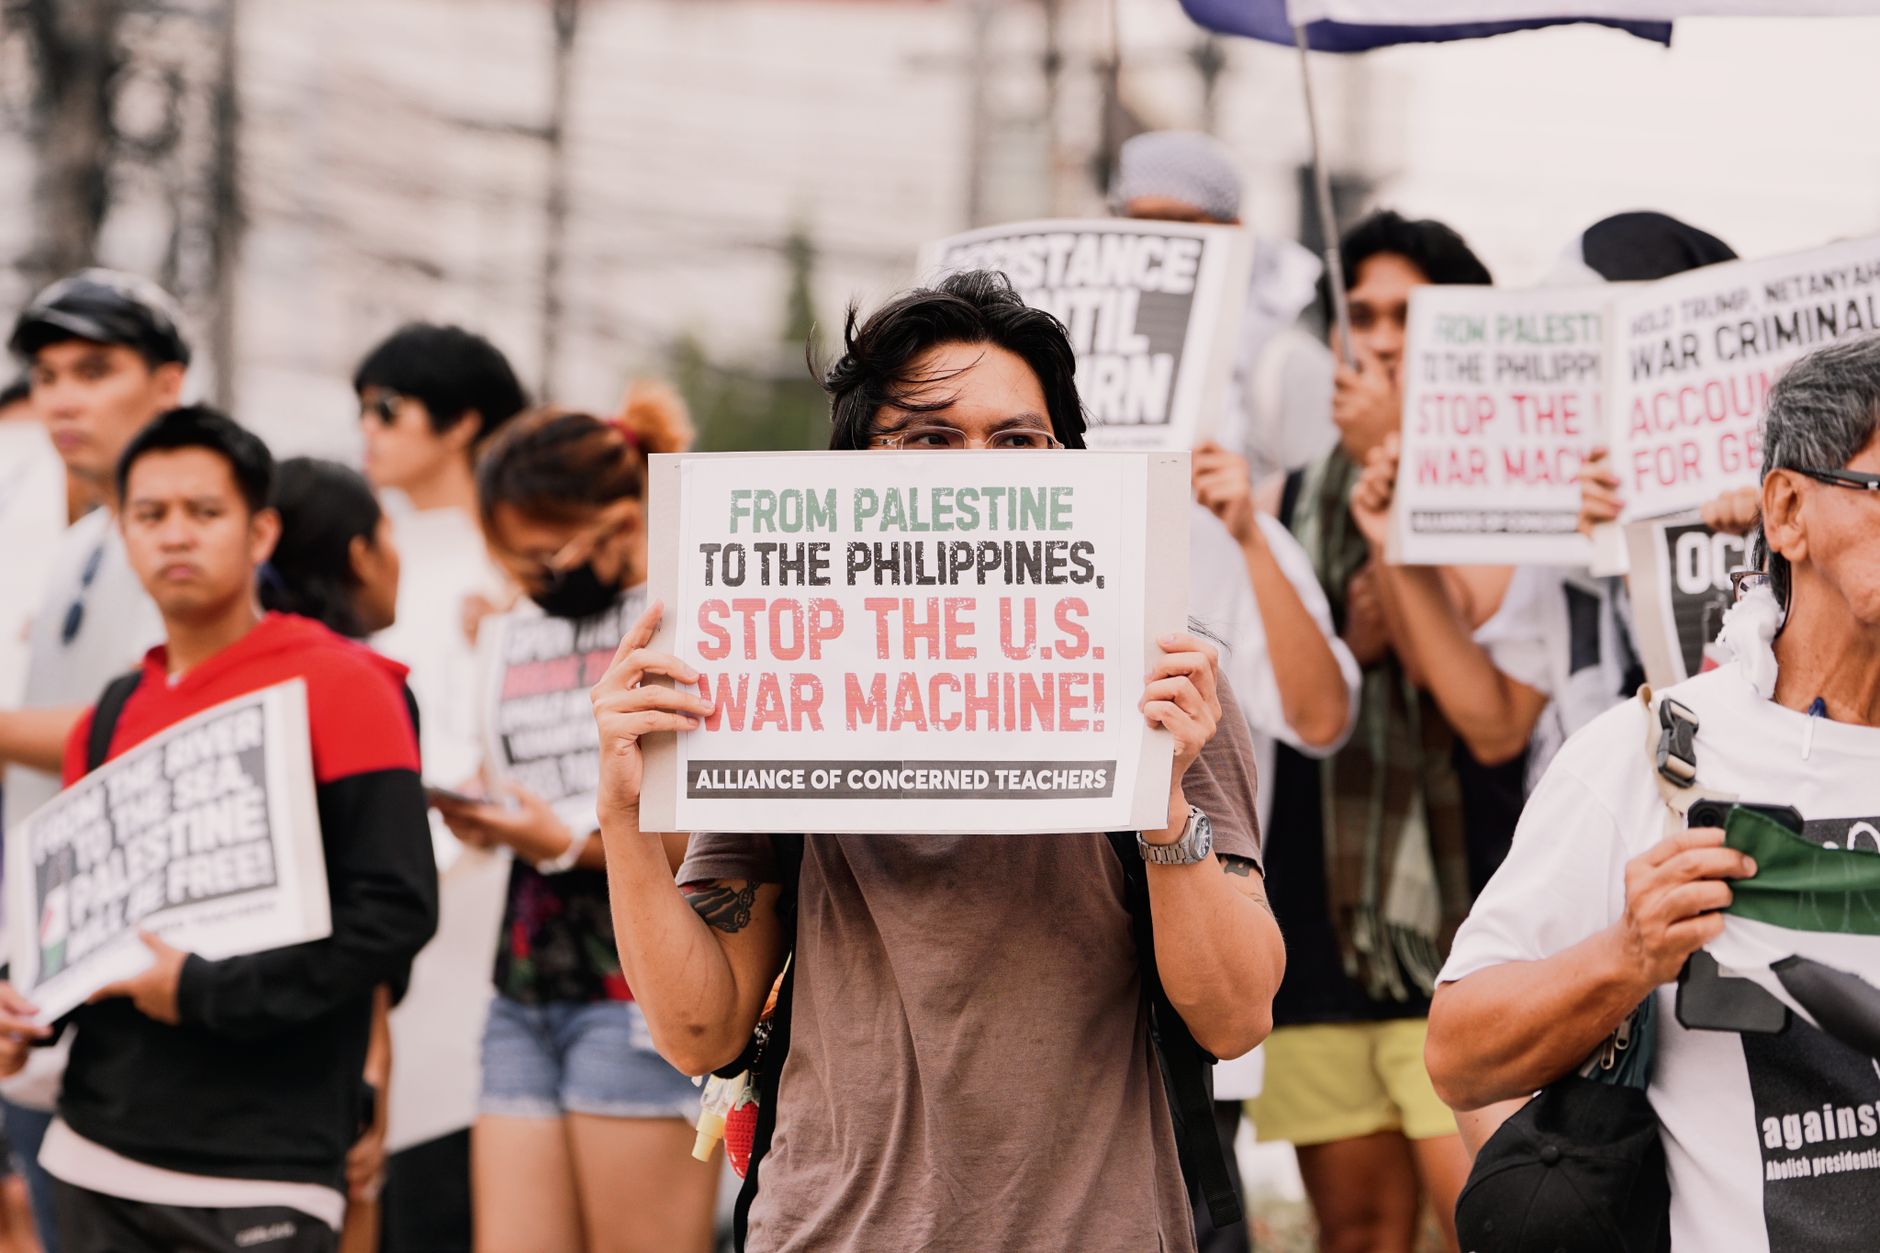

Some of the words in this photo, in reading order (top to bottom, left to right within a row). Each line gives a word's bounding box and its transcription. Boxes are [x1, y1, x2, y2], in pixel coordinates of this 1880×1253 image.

[1763, 262, 1880, 303] NETANYAH
[1631, 333, 1701, 382] WAR
[1714, 295, 1880, 361] CRIMINAL
[1443, 352, 1484, 384] THE
[1416, 393, 1495, 436] STOP
[1511, 393, 1581, 435] THE
[1417, 447, 1490, 487] WAR
[1632, 441, 1702, 491] FOR
[730, 488, 837, 533] FROM
[854, 486, 1073, 532] PALESTINE
[699, 542, 746, 587] TO
[753, 541, 831, 587] THE
[846, 540, 1105, 589] PHILIPPINES,
[697, 598, 845, 661] STOP
[864, 597, 977, 660] THE
[999, 597, 1105, 661] U.S.
[697, 672, 824, 733] WAR
[845, 671, 1105, 732] MACHINE!
[696, 769, 806, 790] ALLIANCE
[811, 769, 842, 790] OF
[847, 769, 990, 791] CONCERNED
[995, 768, 1107, 791] TEACHERS
[1766, 1156, 1812, 1181] Abolish
[1812, 1148, 1880, 1178] presidenti
